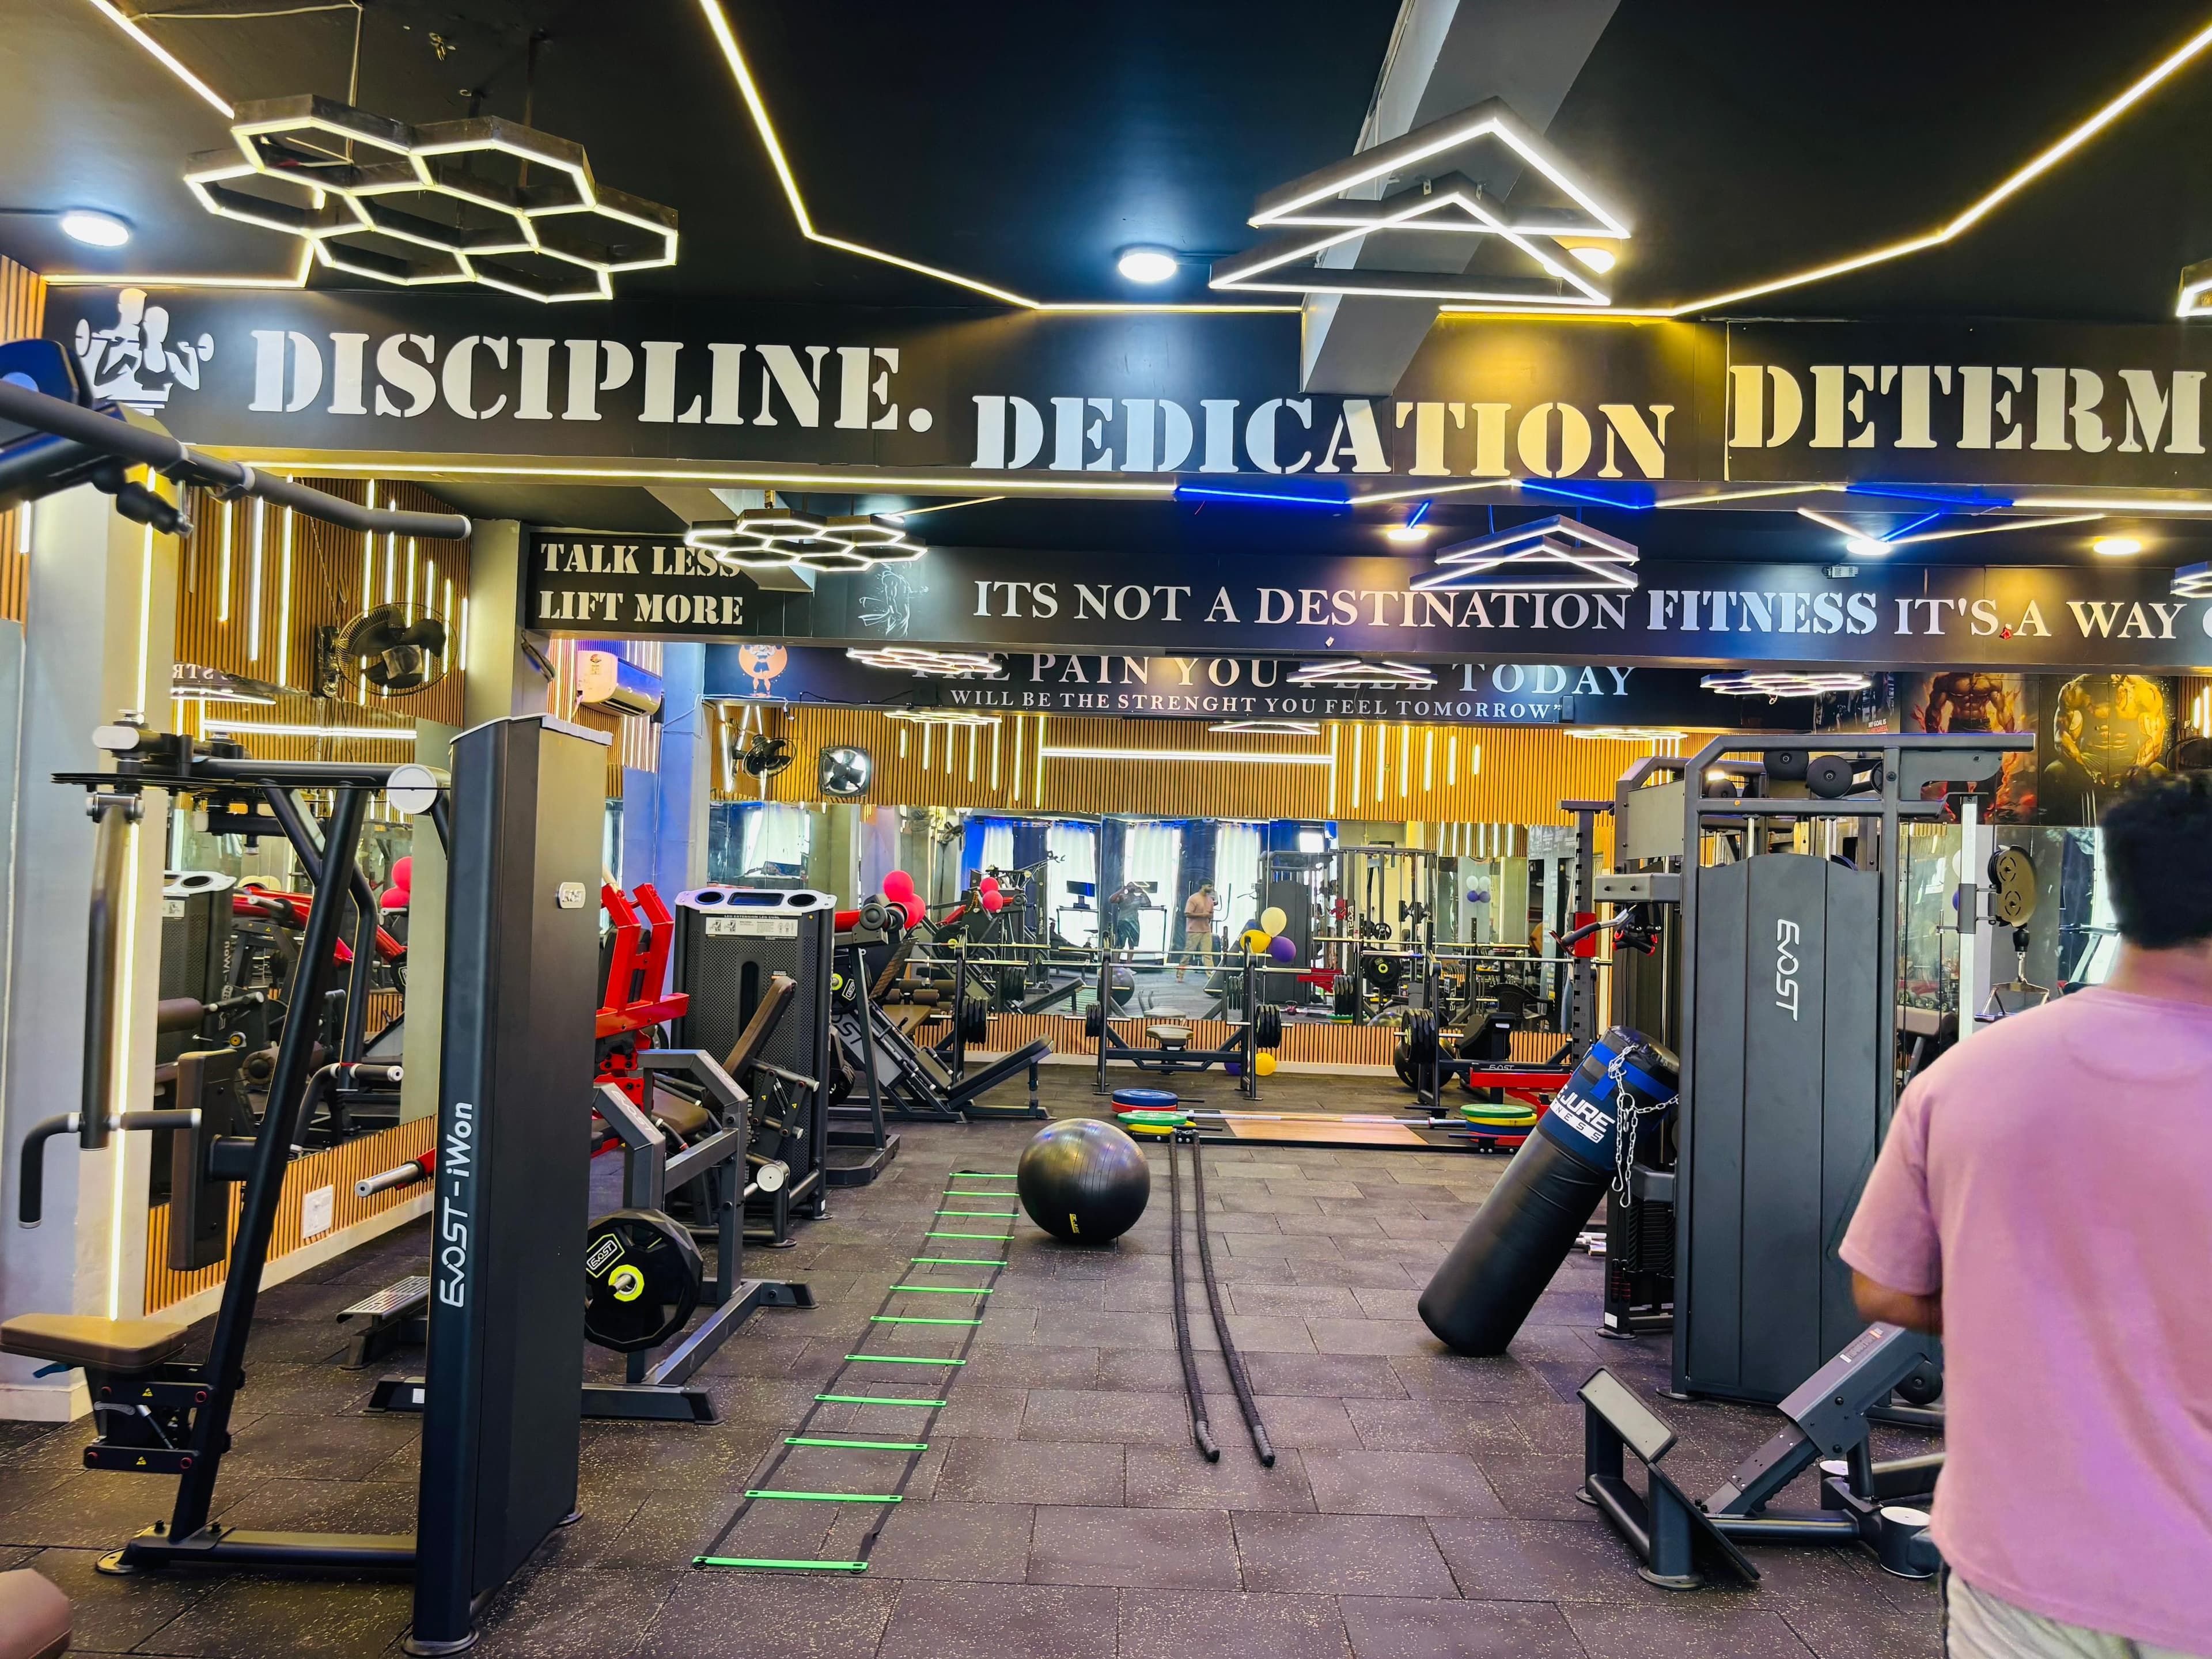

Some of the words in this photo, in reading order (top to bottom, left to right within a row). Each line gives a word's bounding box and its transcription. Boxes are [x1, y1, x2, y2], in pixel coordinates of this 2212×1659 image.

[248, 329, 933, 433] DISCIPLINE.
[1728, 365, 2207, 454] DETERM
[970, 395, 1675, 479] DEDICATION
[541, 543, 639, 574] TALK
[539, 590, 623, 621] LIFT
[634, 593, 743, 625] MORE
[974, 581, 1058, 618] ITS
[1074, 584, 1191, 621] NOT
[1204, 586, 1241, 623] A
[1253, 588, 1632, 630] DESTINATION
[1647, 590, 1878, 635] FITNESS
[1894, 599, 1997, 637] IT'S
[2013, 600, 2052, 638] A
[2065, 601, 2188, 639] WAY
[1029, 653, 1151, 685] PAIN
[1173, 658, 1279, 688] YOU
[1452, 664, 1637, 696] TODAY
[950, 690, 1014, 706] WILL
[1022, 692, 1051, 707] BE
[1060, 693, 1110, 709] THE
[1118, 694, 1256, 713] STRENGHT
[1264, 698, 1316, 713] YOU
[1324, 699, 1387, 715] FEEL
[1775, 919, 1800, 1022] EVOST
[590, 1243, 612, 1267] EVOST
